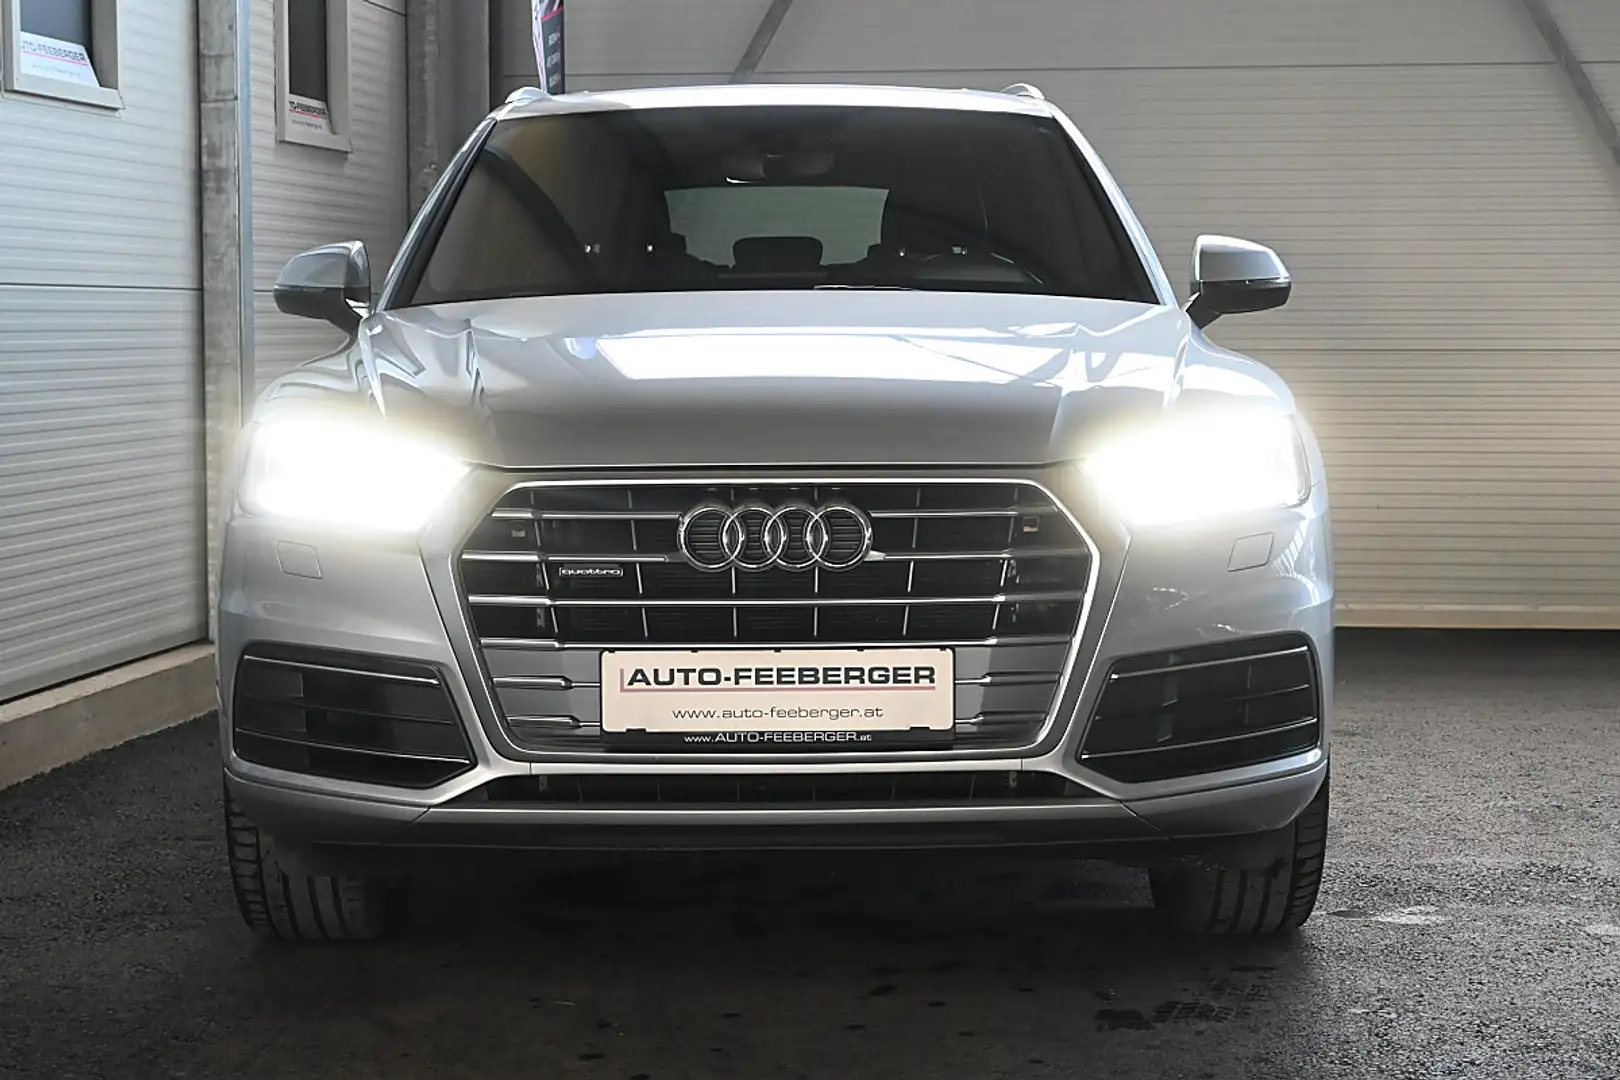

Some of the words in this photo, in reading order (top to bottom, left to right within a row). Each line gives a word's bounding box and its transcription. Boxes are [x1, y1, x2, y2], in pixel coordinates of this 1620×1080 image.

[561, 568, 621, 576] quattro
[627, 666, 936, 686] AUTO-FEEBERGER
[672, 705, 884, 720] www.auto-feeberger.at
[684, 731, 872, 743] www.AUTO-FEEBERGER.at
